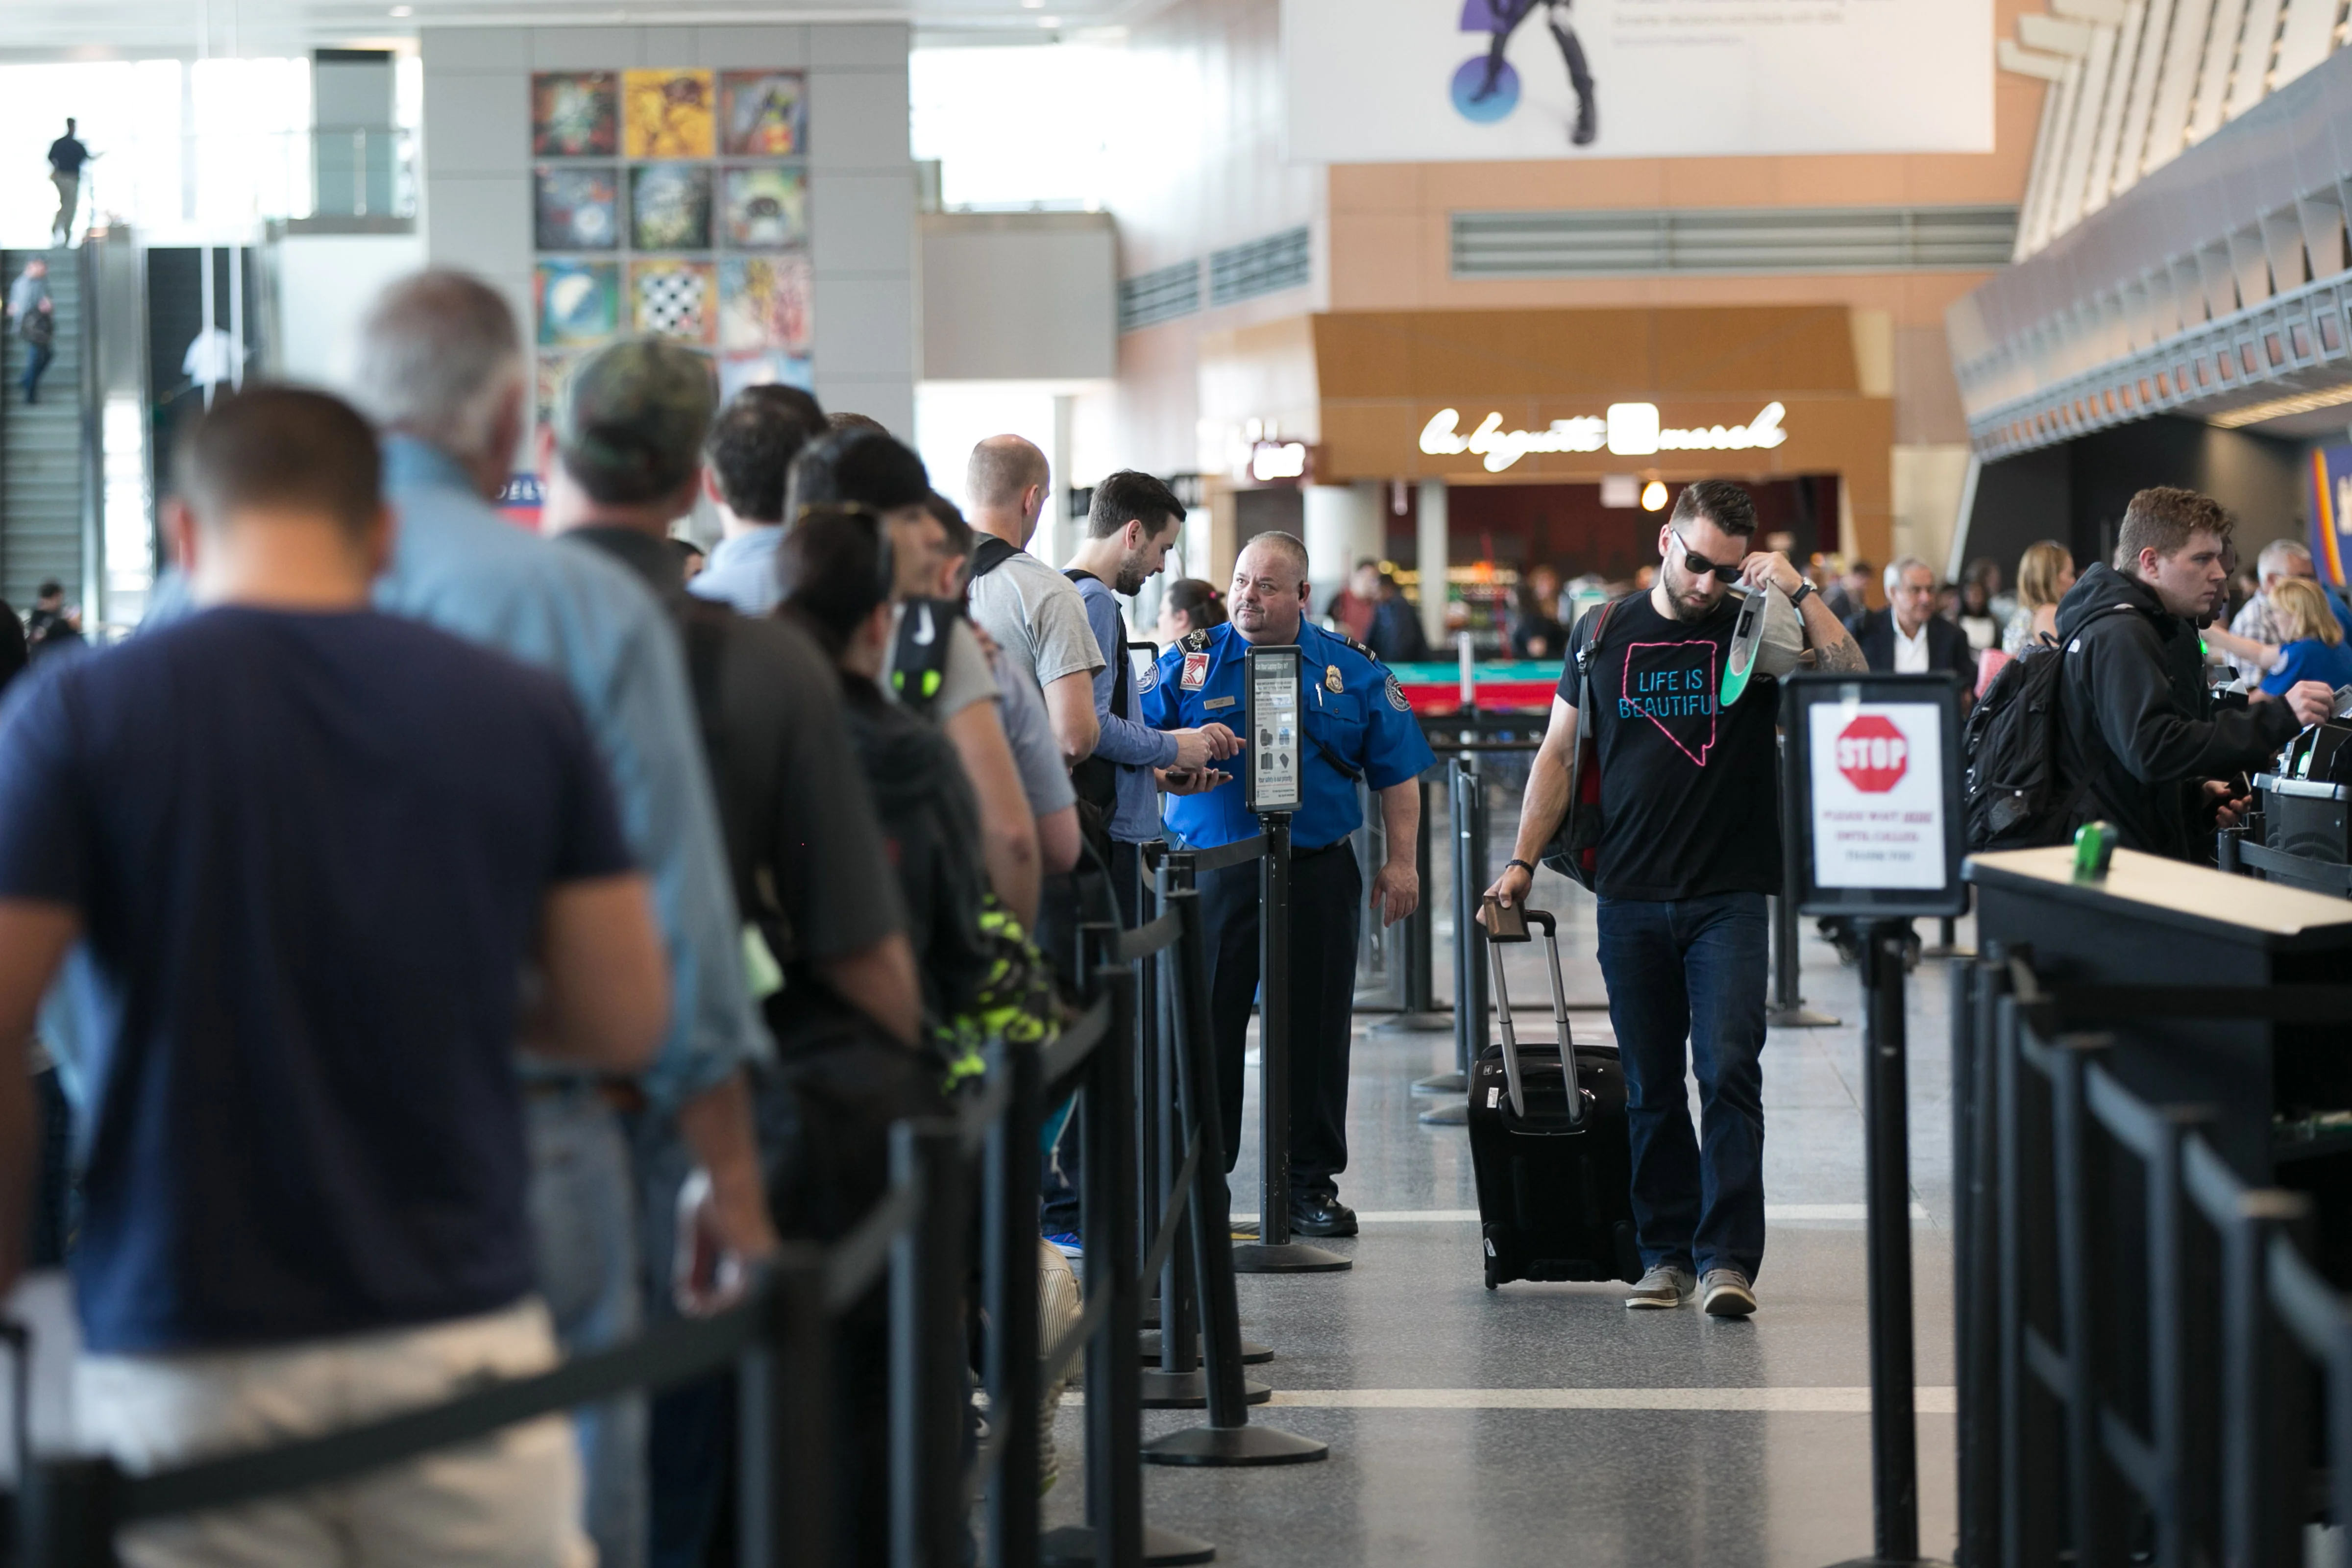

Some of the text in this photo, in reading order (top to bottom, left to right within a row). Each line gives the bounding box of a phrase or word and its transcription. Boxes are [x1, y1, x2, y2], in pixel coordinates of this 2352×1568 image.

[1640, 669, 1703, 692] LIFE IS
[1618, 695, 1725, 719] BEAUTIFUL
[1838, 737, 1906, 769] STOP
